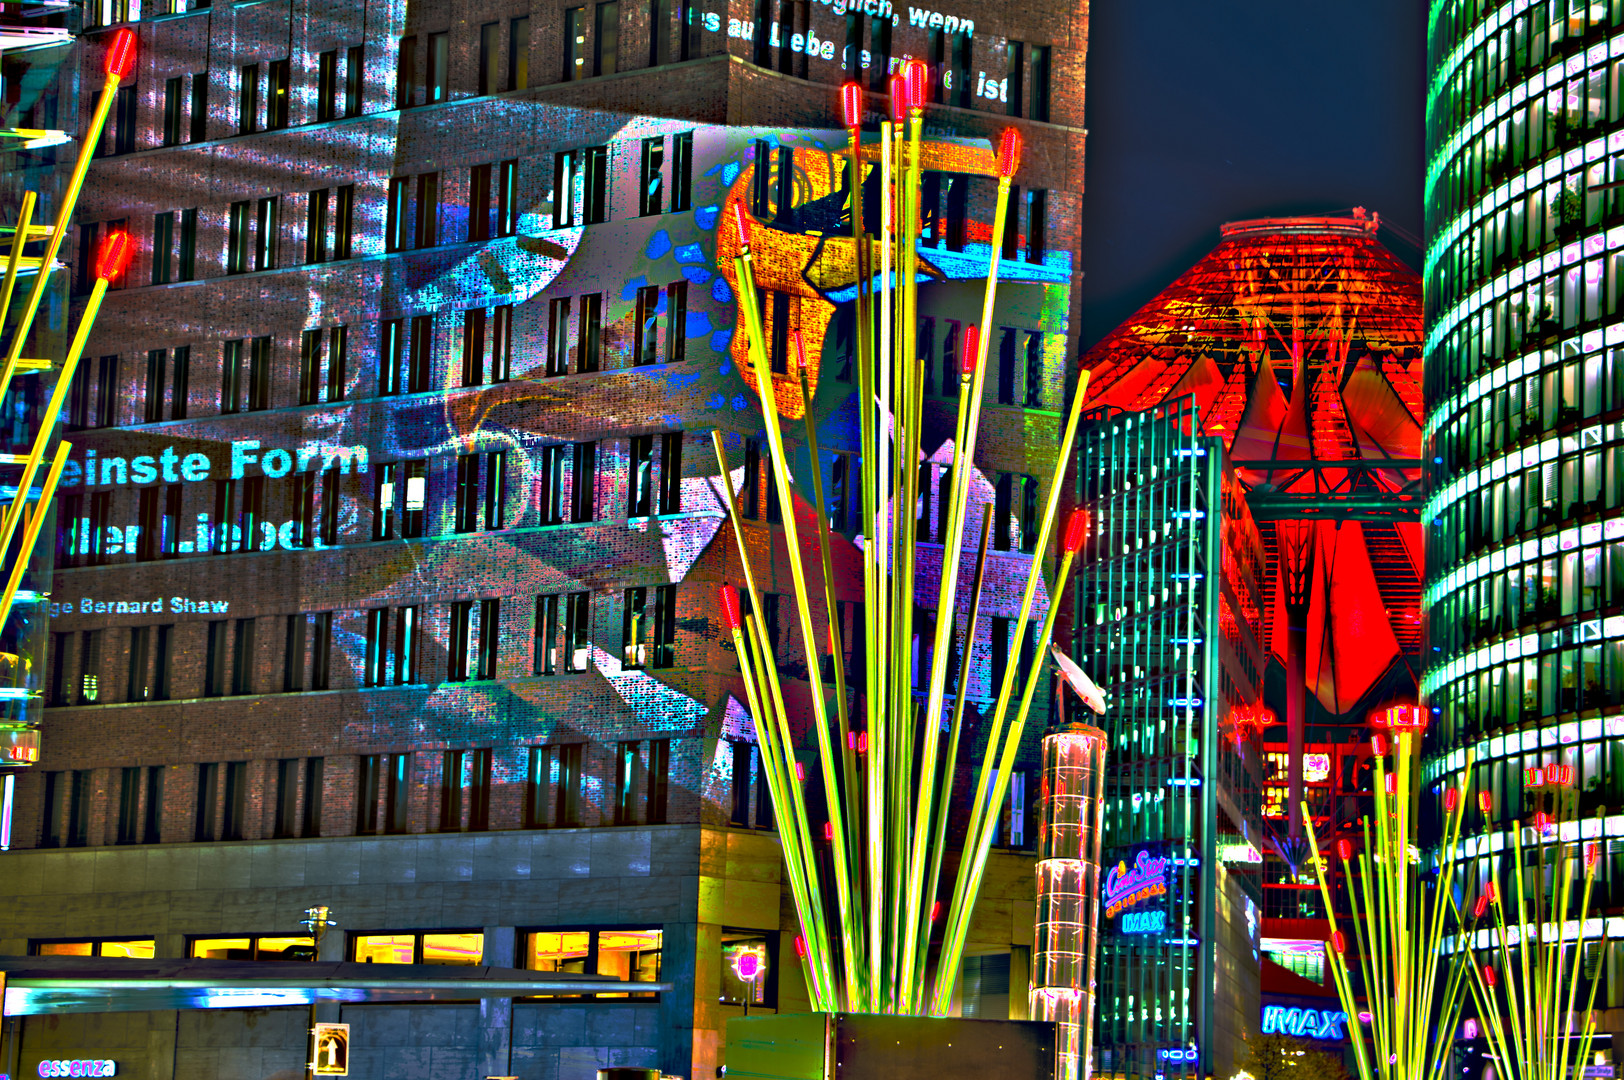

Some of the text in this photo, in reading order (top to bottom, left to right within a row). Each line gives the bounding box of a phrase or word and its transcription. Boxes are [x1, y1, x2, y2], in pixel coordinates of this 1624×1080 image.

[908, 6, 974, 38] wenn
[769, 21, 835, 60] Lebe
[976, 71, 1008, 103] ist
[231, 440, 369, 480] Form
[80, 597, 163, 614] Bernard
[170, 596, 229, 614] Shaw
[1122, 910, 1166, 933] IMAX
[1261, 1005, 1344, 1039] IMAX
[38, 1059, 116, 1078] essenza
